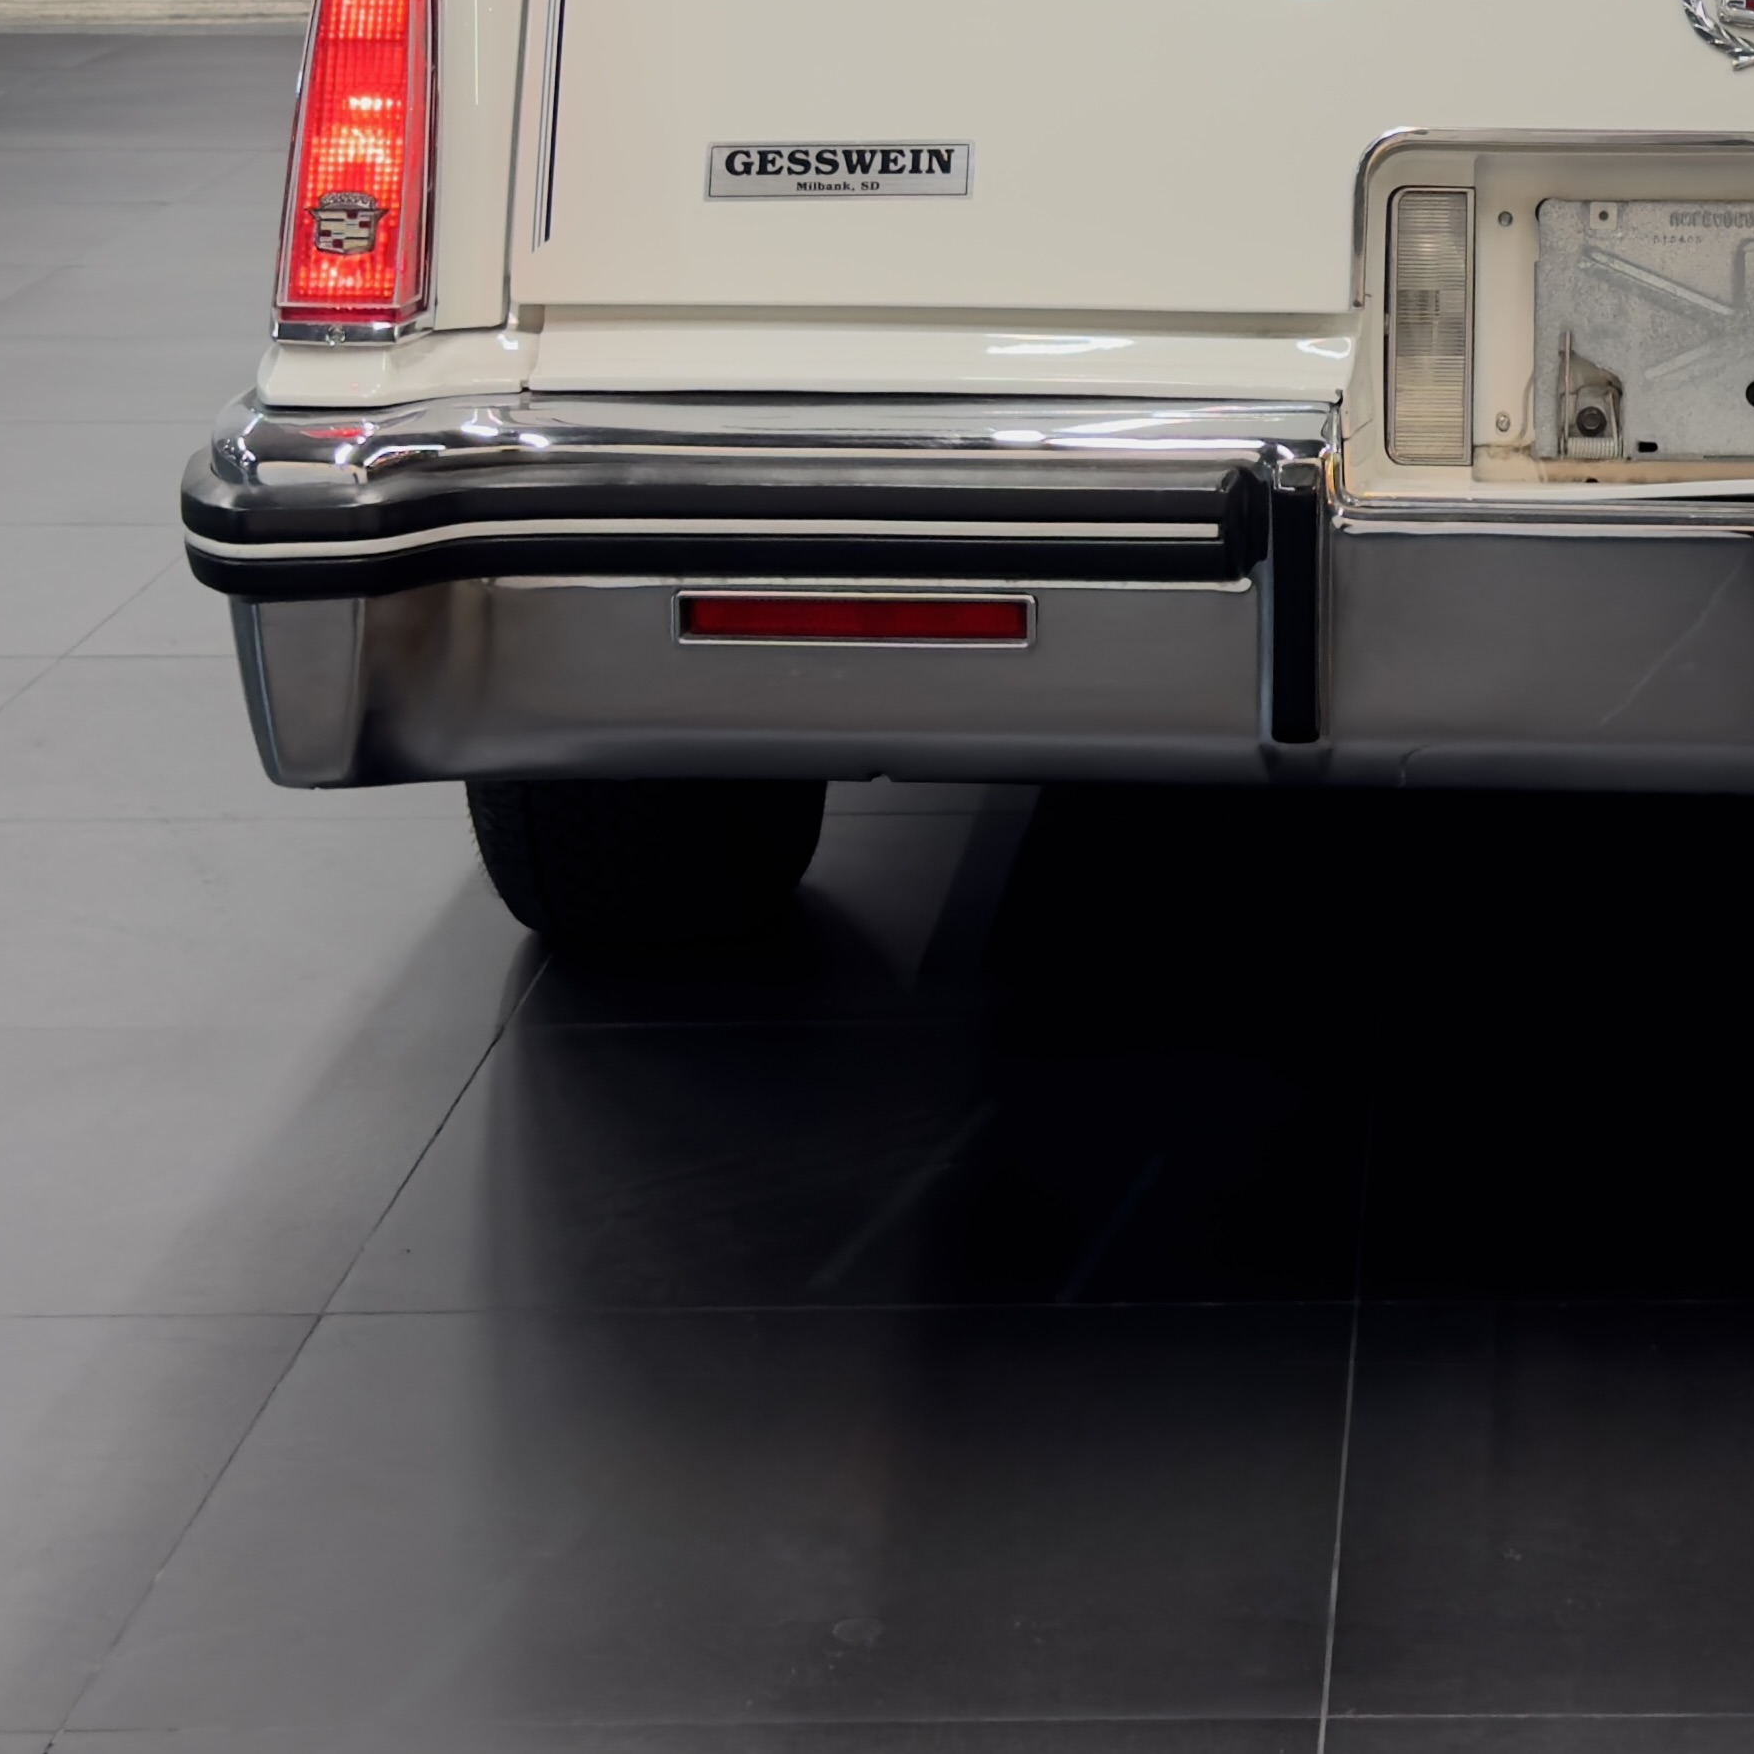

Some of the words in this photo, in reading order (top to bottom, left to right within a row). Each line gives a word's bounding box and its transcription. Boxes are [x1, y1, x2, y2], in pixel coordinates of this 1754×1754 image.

[724, 148, 955, 176] GESSWEIN
[796, 181, 856, 192] Milbank,
[860, 181, 881, 191] SD
